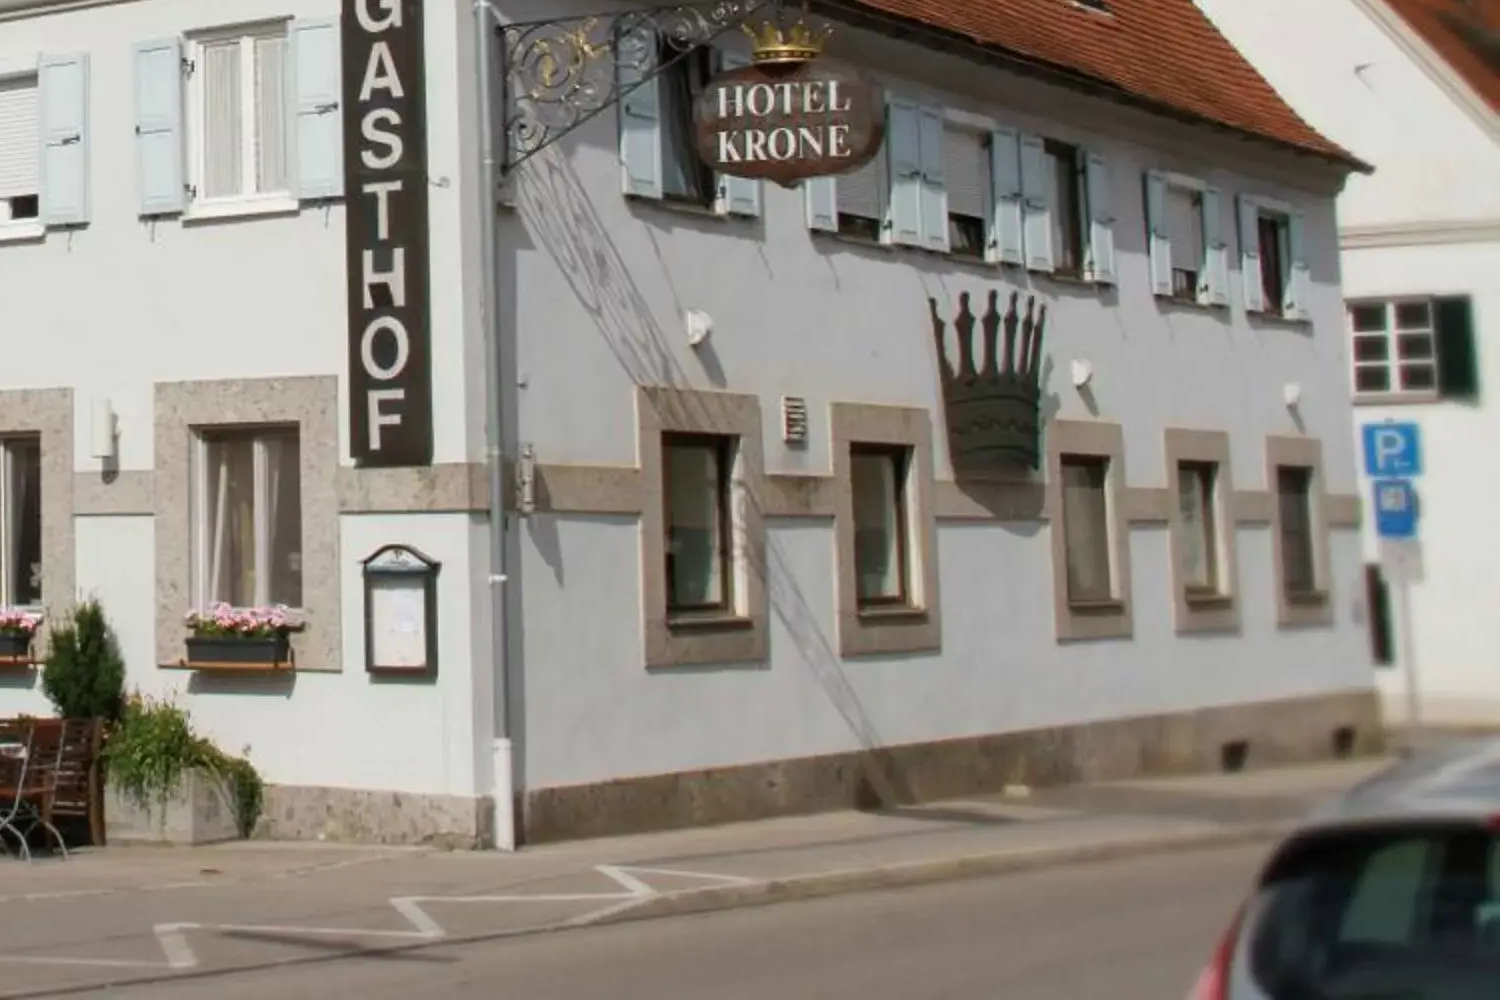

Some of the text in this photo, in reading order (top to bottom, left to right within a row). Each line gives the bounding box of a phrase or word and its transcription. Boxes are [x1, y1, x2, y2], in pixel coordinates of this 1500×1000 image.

[717, 80, 851, 118] HOTEL
[717, 124, 851, 163] KRONE
[1375, 428, 1406, 470] P
